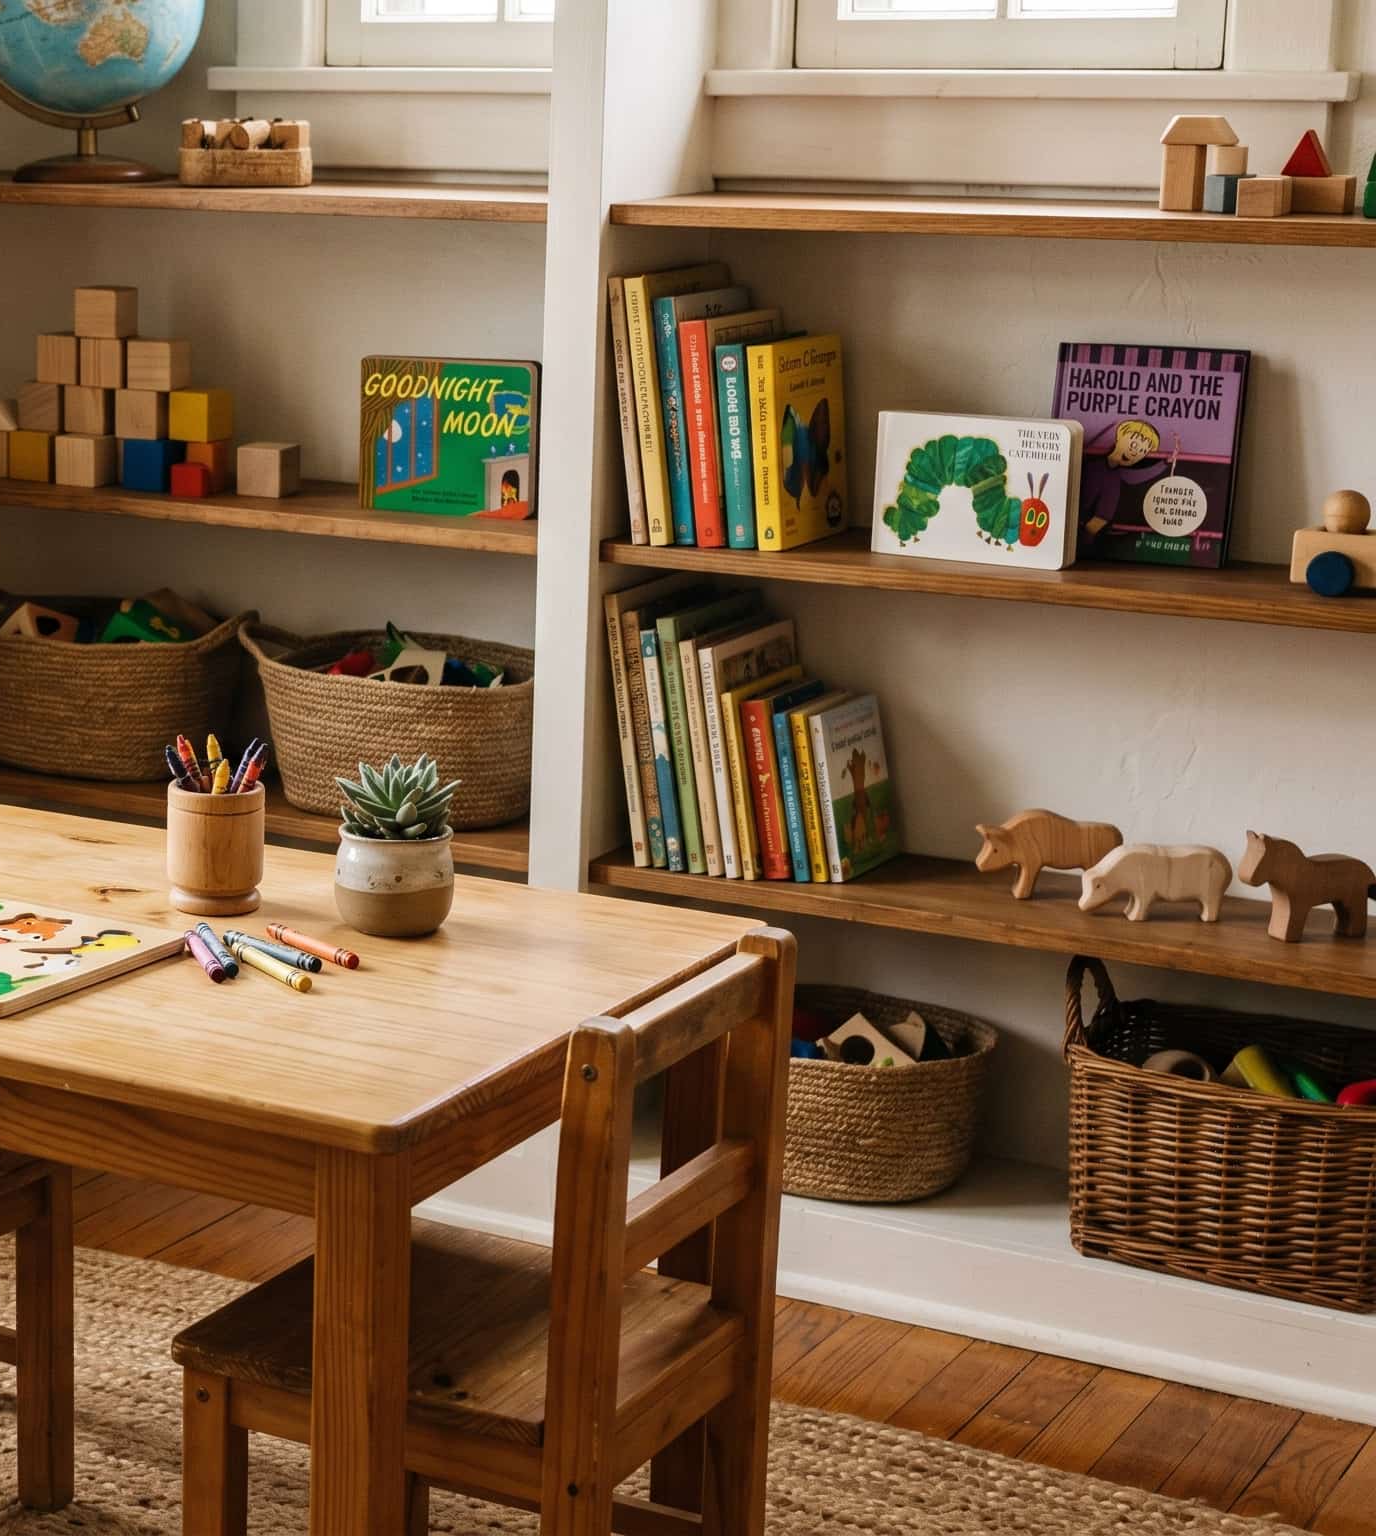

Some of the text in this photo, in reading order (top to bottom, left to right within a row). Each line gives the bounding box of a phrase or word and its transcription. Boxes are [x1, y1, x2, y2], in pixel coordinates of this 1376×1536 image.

[364, 373, 504, 403] GOODNIGHT
[1068, 367, 1225, 397] HAROLD AND THE
[1066, 391, 1222, 421] PURPLE CRAYON
[442, 410, 518, 438] MOON
